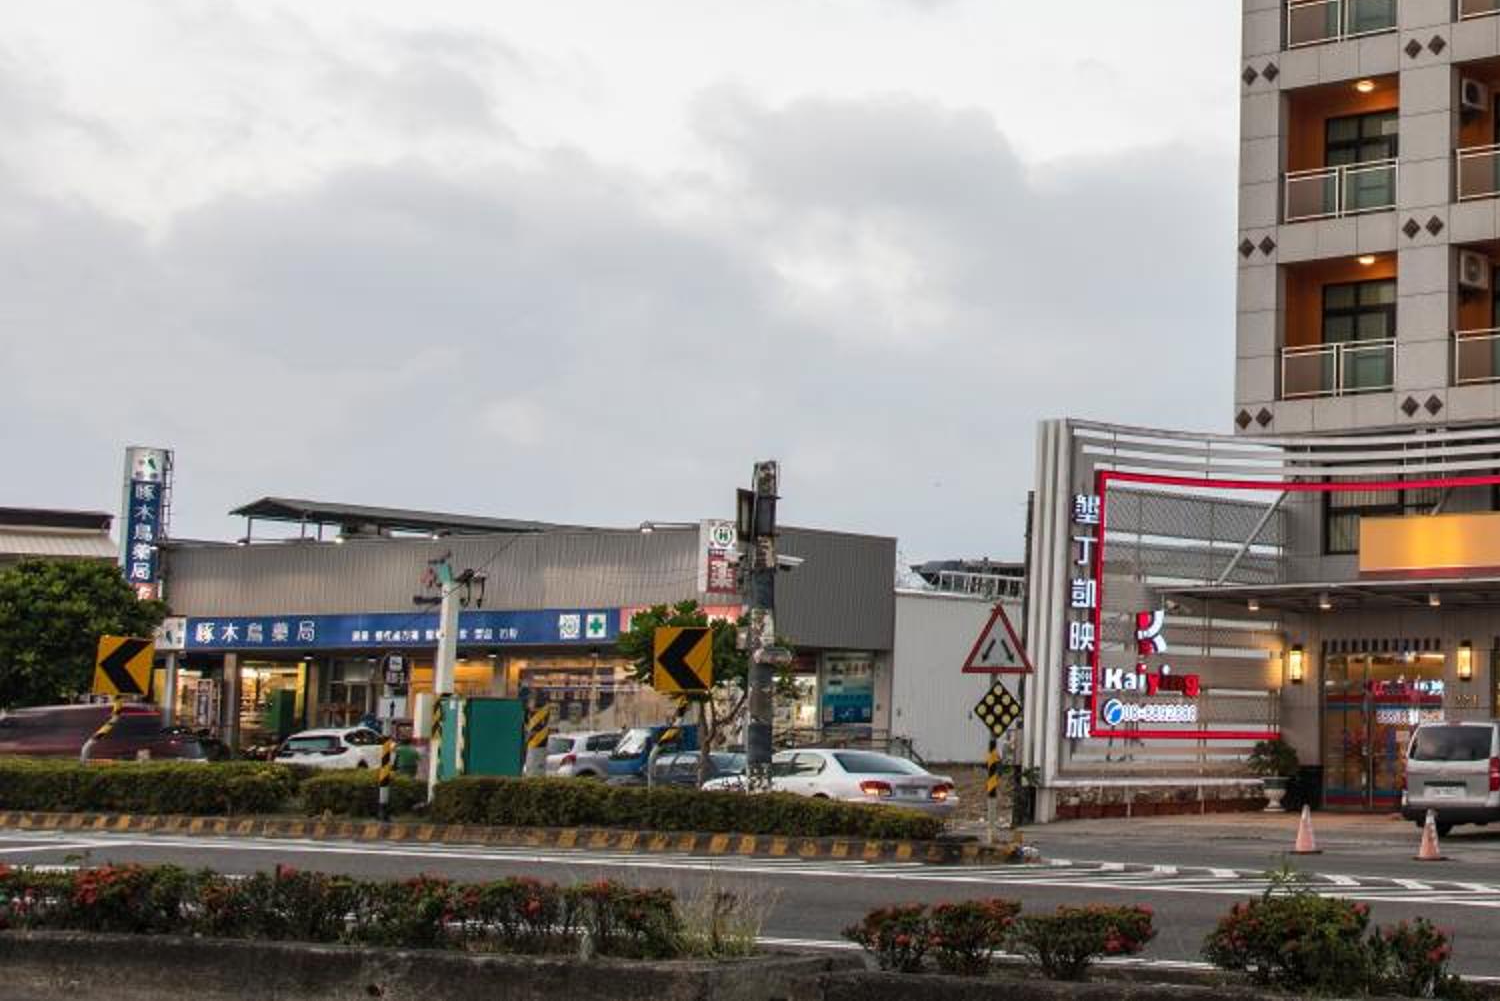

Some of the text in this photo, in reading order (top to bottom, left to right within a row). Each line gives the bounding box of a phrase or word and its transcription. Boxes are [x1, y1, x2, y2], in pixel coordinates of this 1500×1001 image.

[1066, 494, 1100, 738] 墾丁凱映輕旅
[1104, 663, 1200, 696] Kaiying
